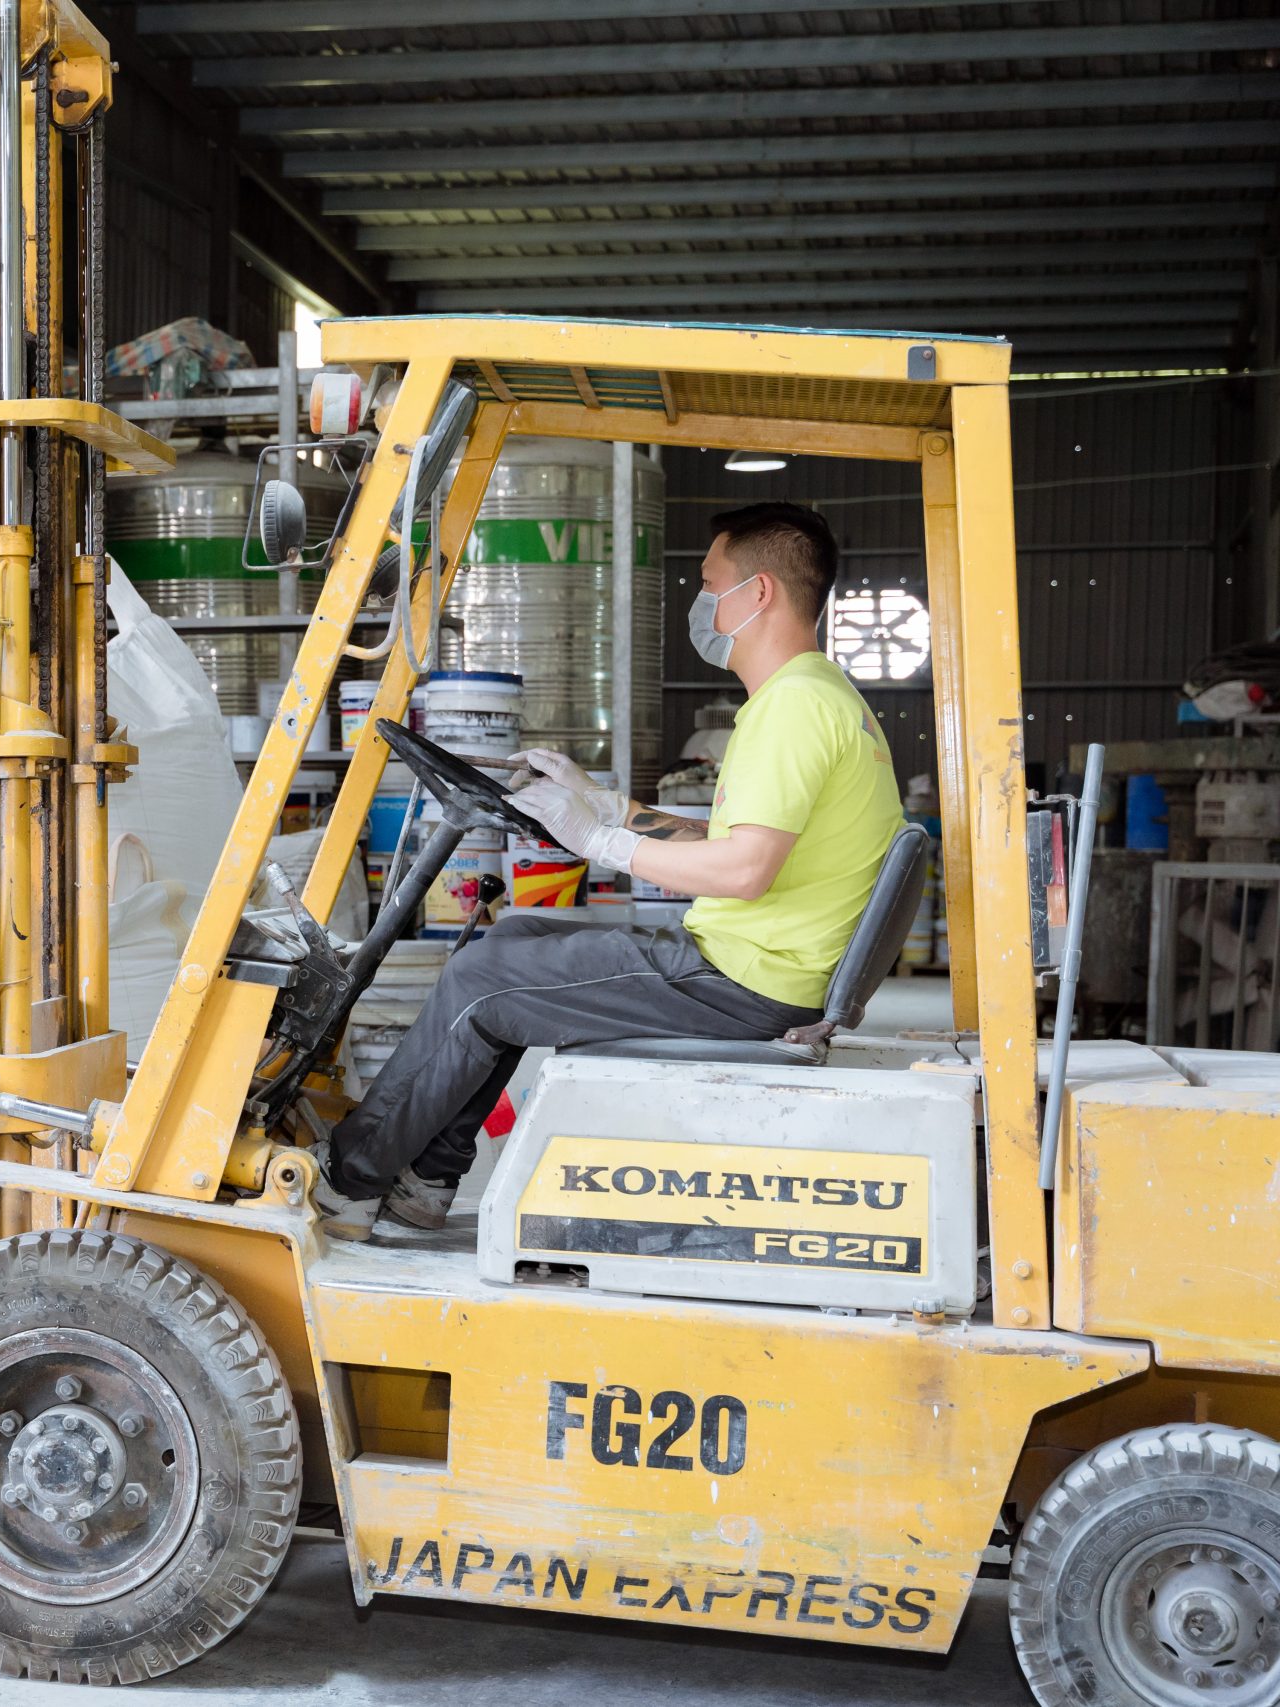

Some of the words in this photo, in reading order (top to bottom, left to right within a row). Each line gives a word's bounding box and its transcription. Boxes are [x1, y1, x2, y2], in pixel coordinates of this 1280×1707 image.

[538, 521, 615, 562] VIE
[560, 1164, 907, 1211] KOMATSU
[754, 1232, 908, 1266] FG20
[546, 1380, 747, 1475] FG20
[368, 1536, 588, 1600] JAPAN
[615, 1569, 937, 1634] EXPRESS
